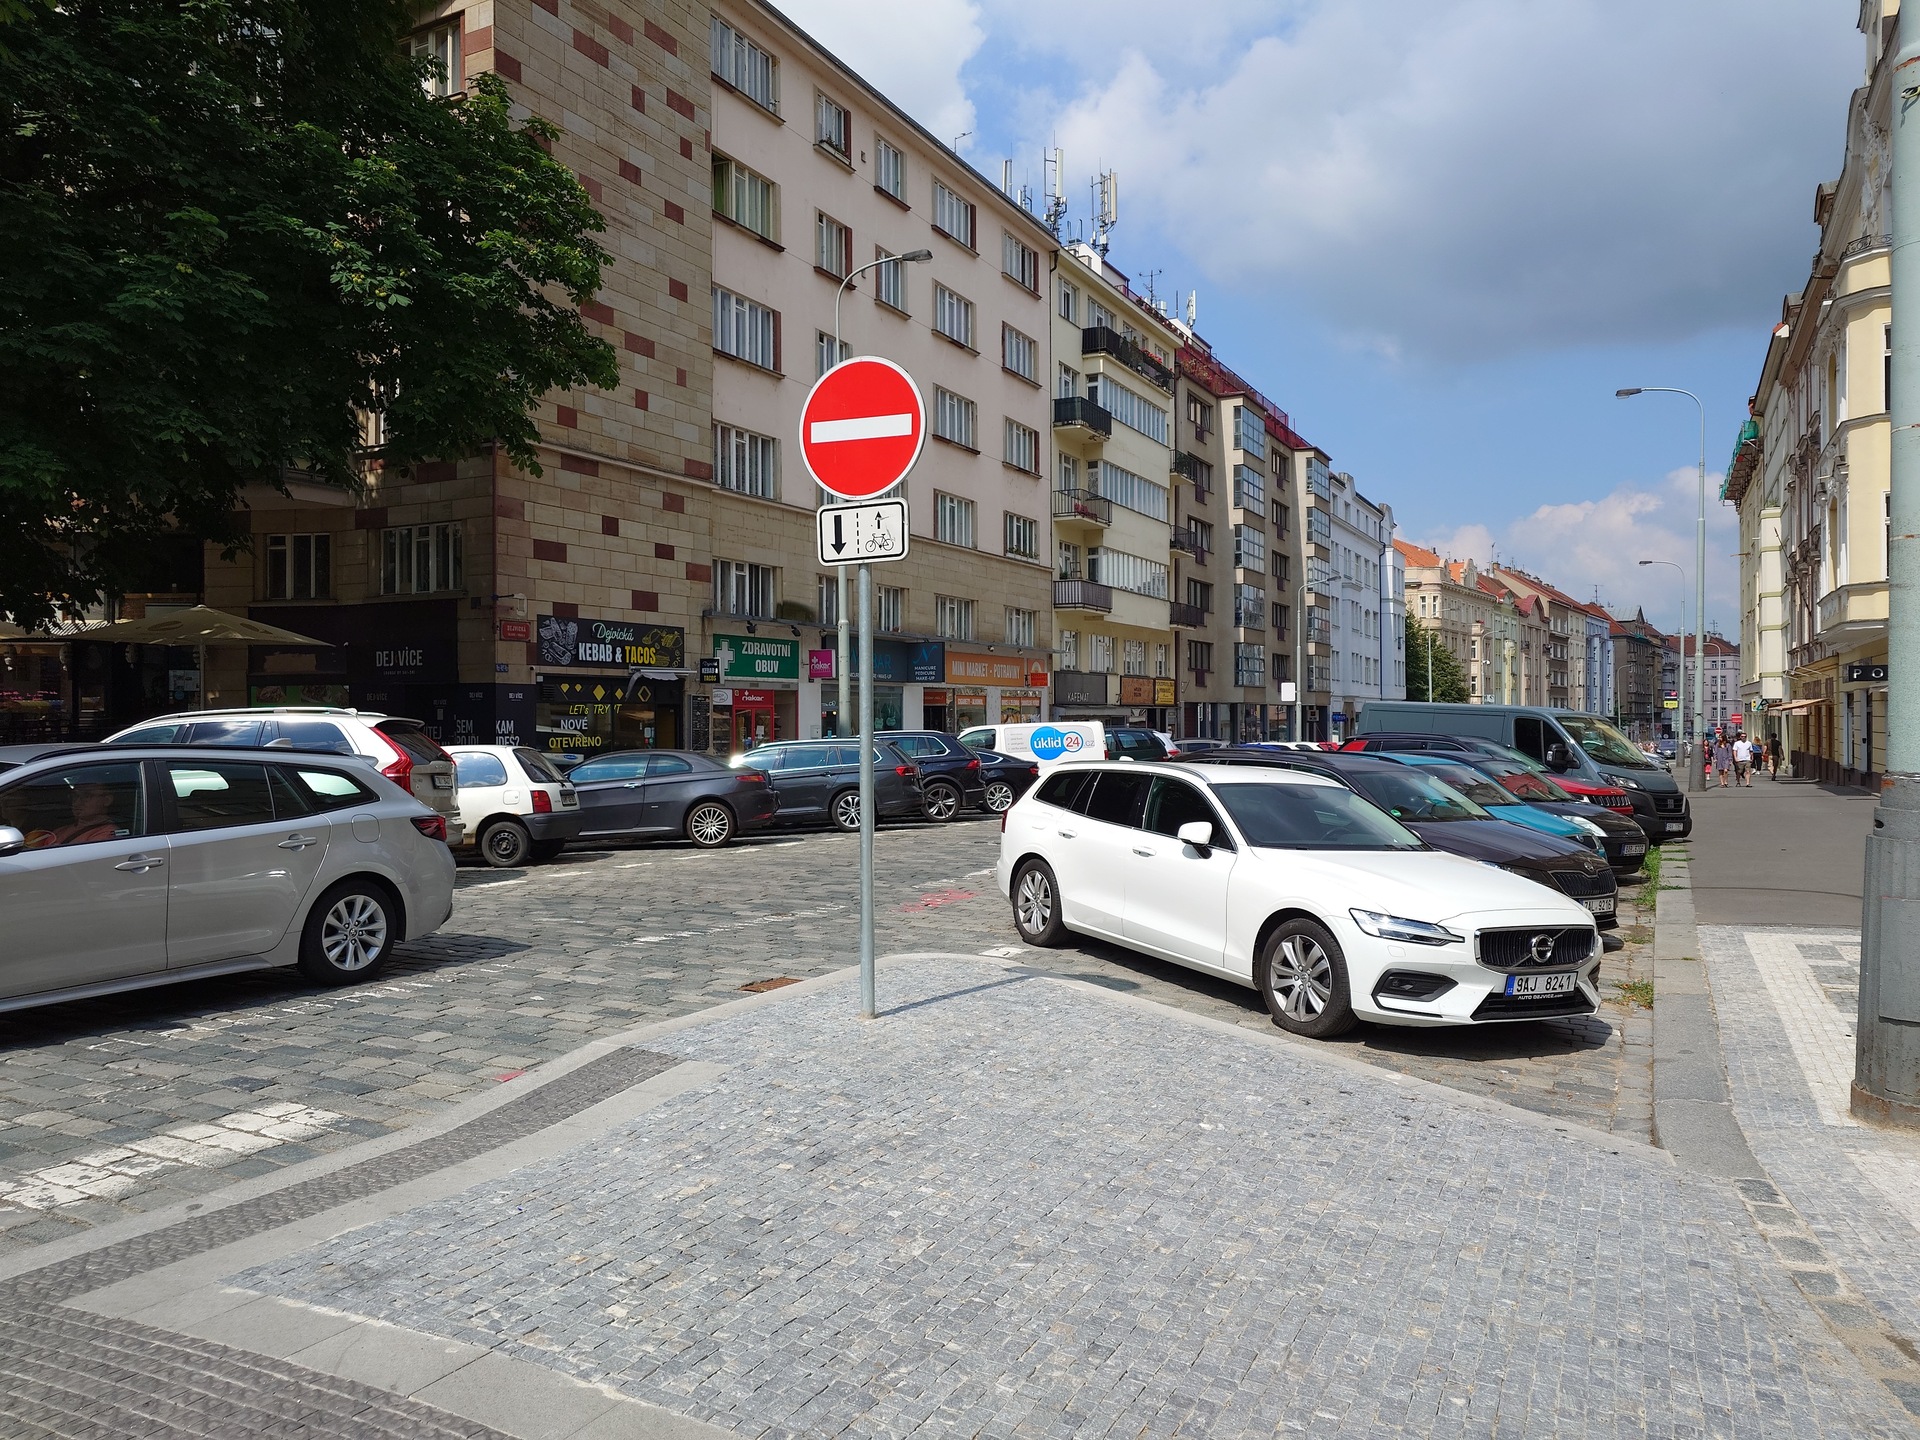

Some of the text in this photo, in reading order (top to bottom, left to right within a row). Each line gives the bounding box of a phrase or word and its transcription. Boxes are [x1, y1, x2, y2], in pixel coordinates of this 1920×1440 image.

[592, 622, 635, 643] Dejvická
[578, 642, 657, 665] KEBAB & TACOS
[741, 641, 792, 657] ZDRAVOTNÍ
[376, 650, 394, 667] DEJ
[755, 659, 779, 674] OBUV
[952, 660, 965, 676] MINI
[966, 662, 988, 678] MARKET
[993, 663, 1020, 679] POTRAVINY
[594, 703, 610, 715] TRY
[495, 720, 514, 735] KAM
[560, 716, 588, 730] NOVÉ
[548, 734, 602, 749] OTEVŘENO
[1033, 737, 1062, 749] úklid
[1065, 736, 1081, 748] 24
[1516, 974, 1571, 993] 9AJ 8241
